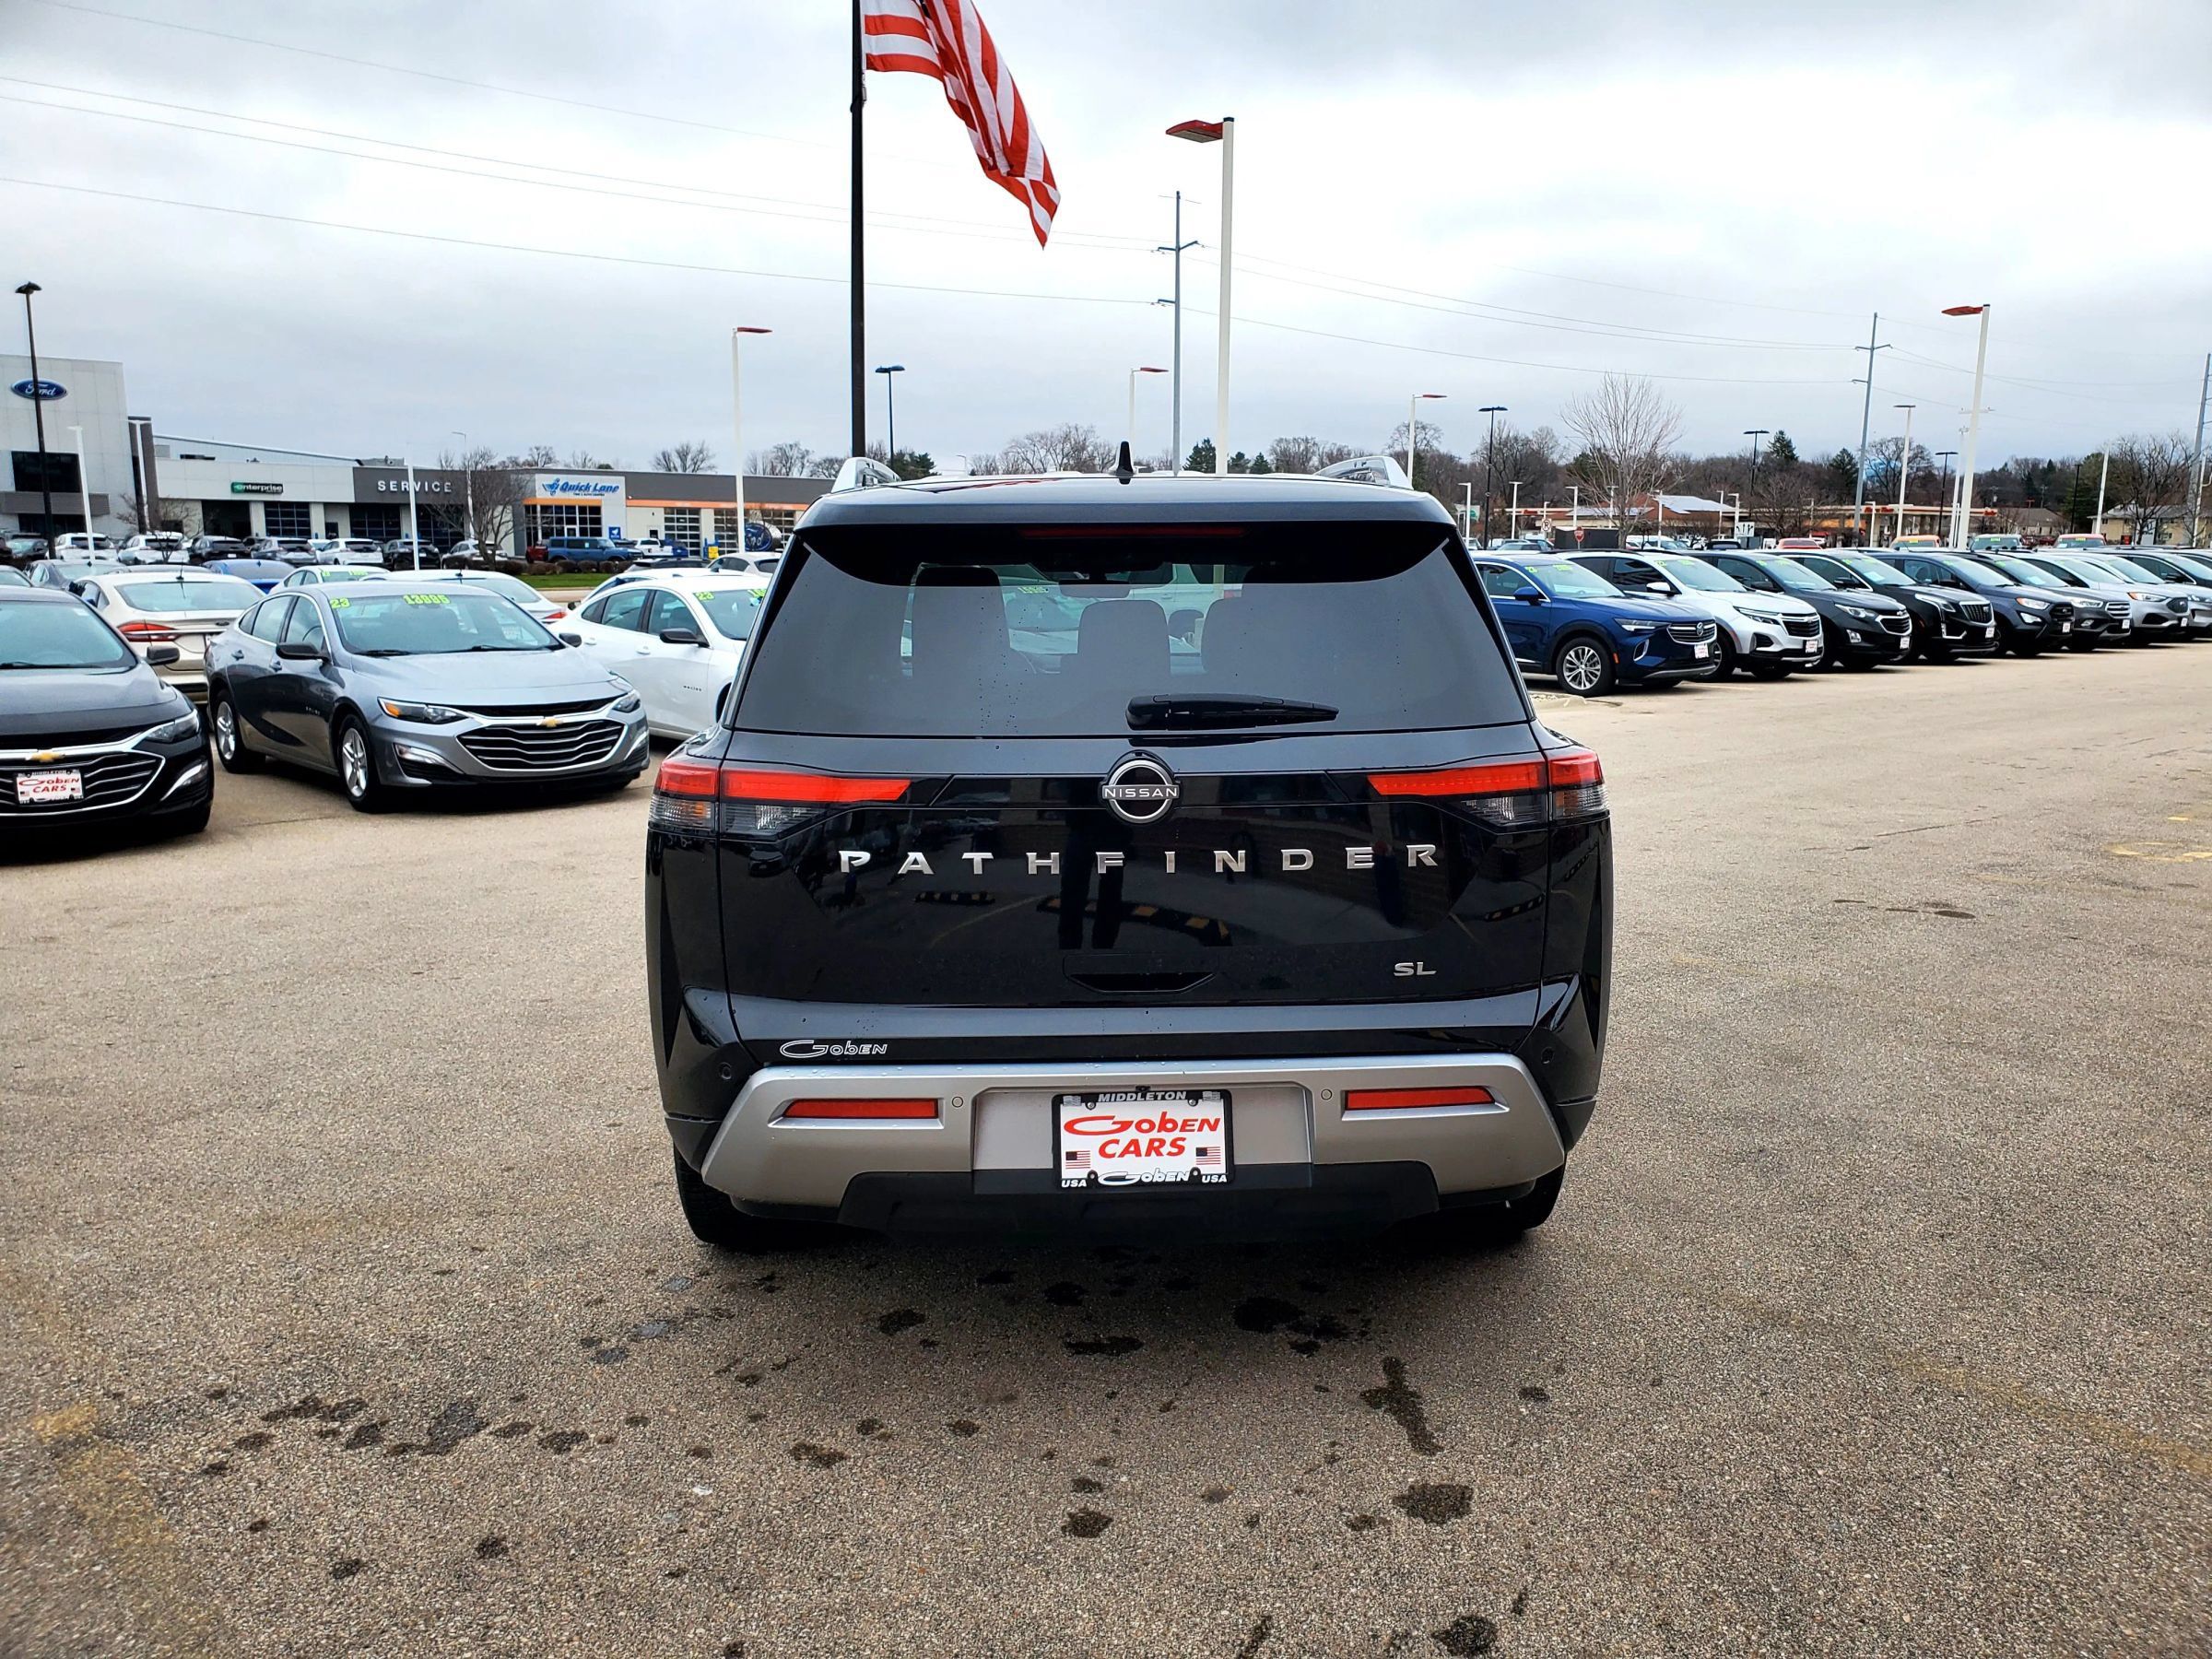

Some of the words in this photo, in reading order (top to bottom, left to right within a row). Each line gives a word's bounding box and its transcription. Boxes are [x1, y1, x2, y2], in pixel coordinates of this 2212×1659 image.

[377, 480, 452, 492] SERVICE
[559, 481, 592, 492] Quick
[591, 482, 619, 493] Lane
[330, 597, 350, 608] 23
[33, 785, 66, 794] CARS
[1104, 787, 1177, 798] NISSAN
[838, 844, 1438, 875] PATHFINDER
[1393, 961, 1437, 977] SL
[1098, 1090, 1187, 1103] MIDDLETON
[1098, 1137, 1187, 1159] CARS
[1061, 1179, 1088, 1188] USA
[1201, 1173, 1228, 1183] USA
